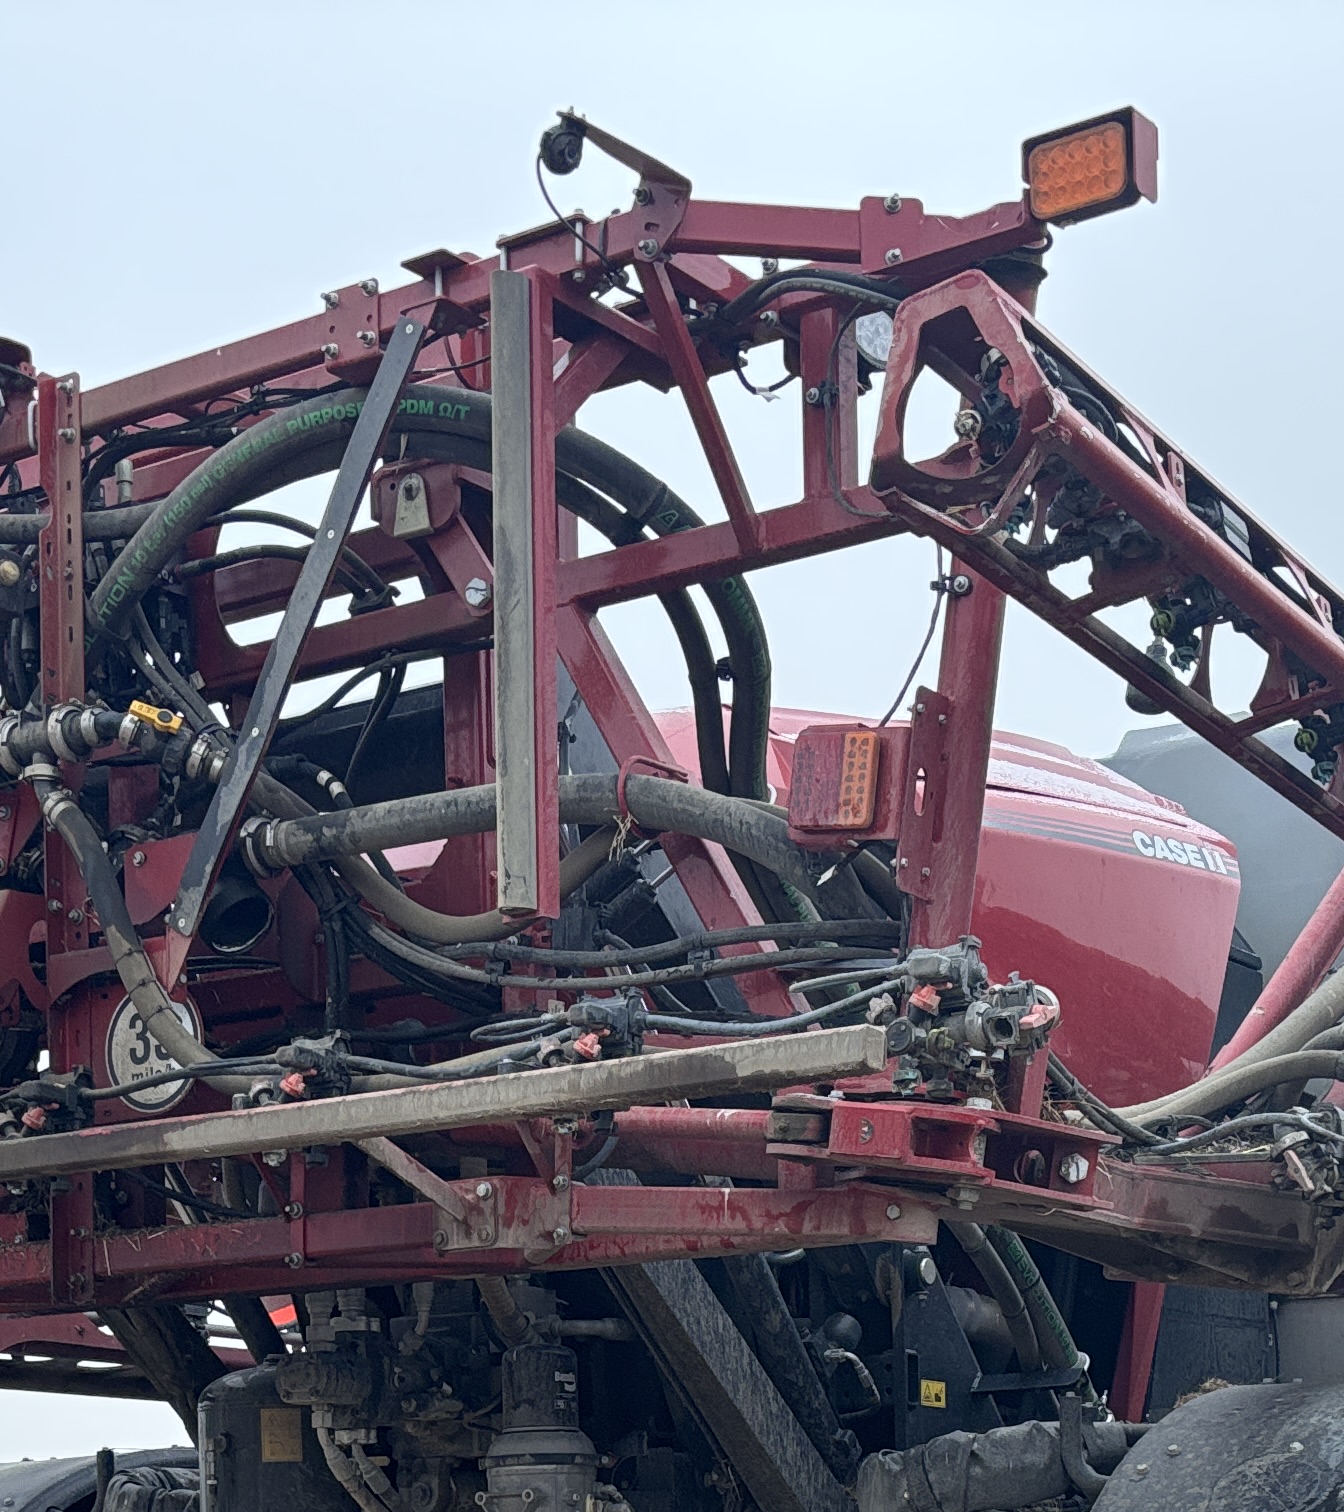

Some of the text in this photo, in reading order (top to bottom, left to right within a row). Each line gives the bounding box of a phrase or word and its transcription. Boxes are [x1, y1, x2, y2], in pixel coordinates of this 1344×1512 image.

[214, 426, 282, 478] GENERAL
[396, 399, 434, 416] PDM
[1132, 830, 1205, 869] CASE
